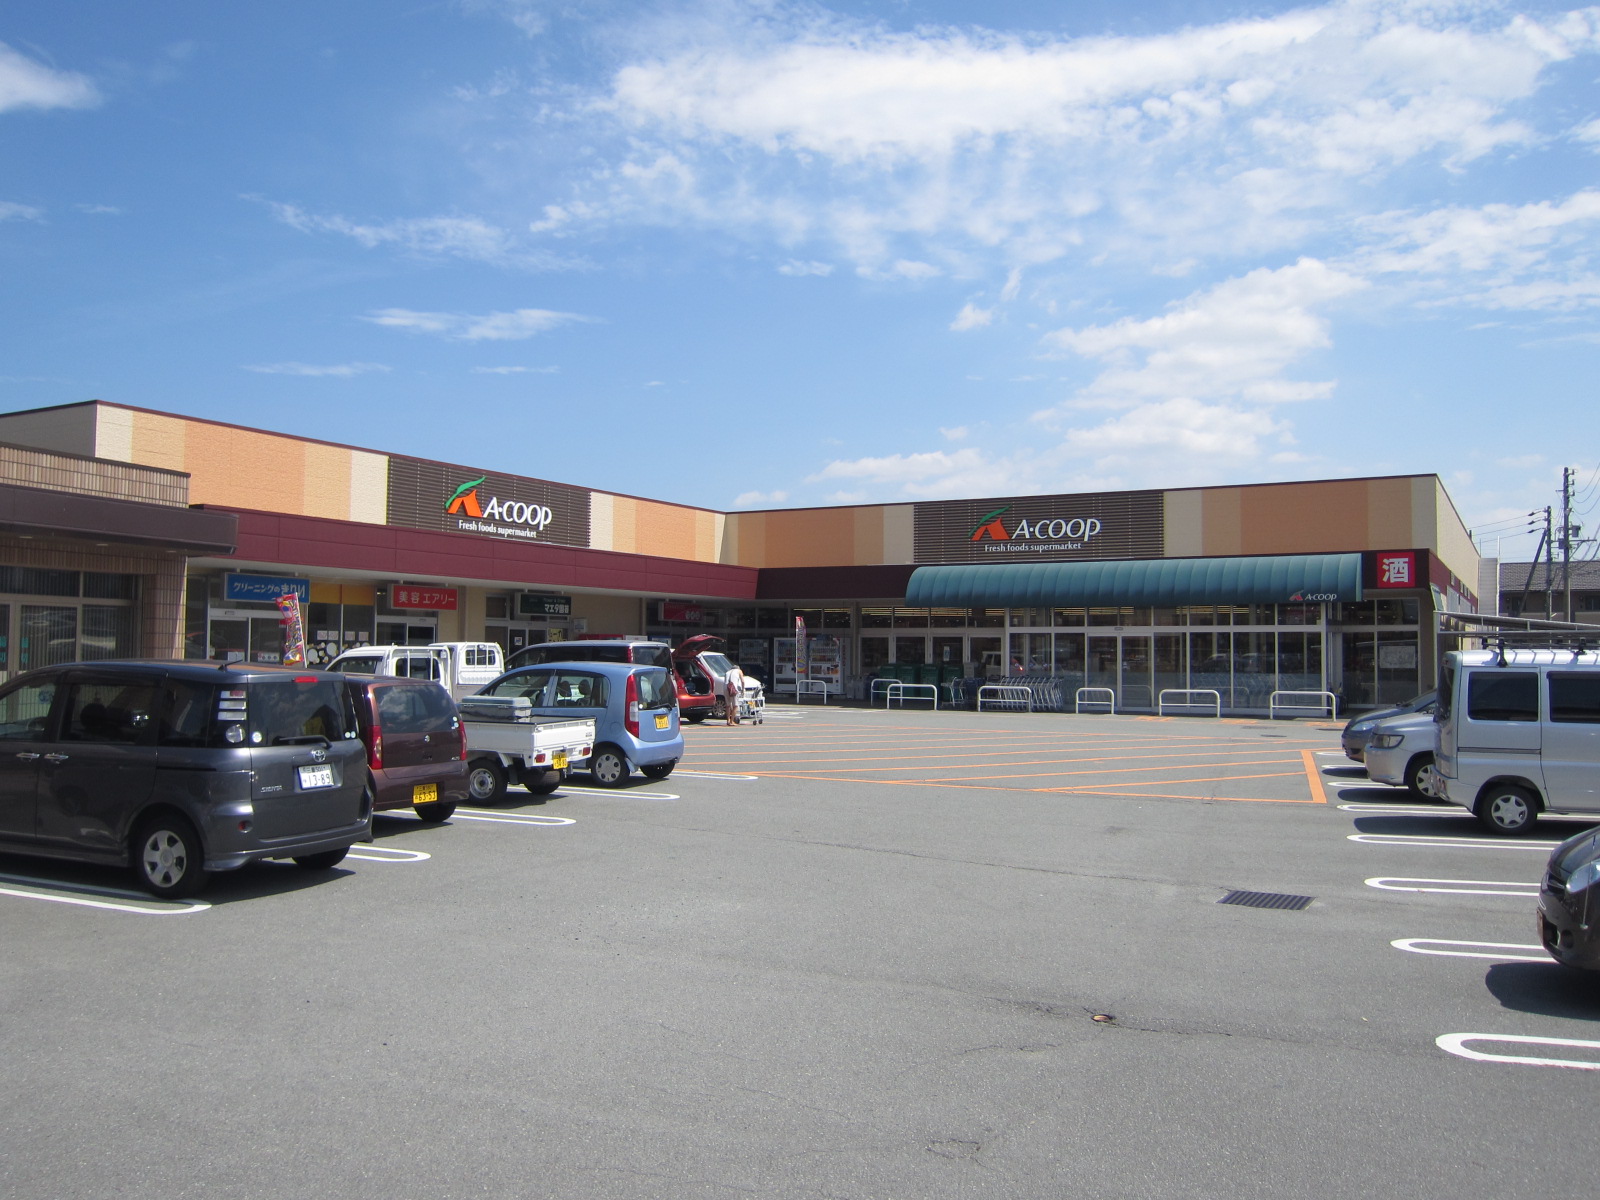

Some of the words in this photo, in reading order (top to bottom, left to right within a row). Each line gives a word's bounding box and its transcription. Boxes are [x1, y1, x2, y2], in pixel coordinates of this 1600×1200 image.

[458, 519, 478, 531] Fresh
[478, 521, 497, 533] foods
[497, 526, 537, 538] supermarket
[984, 544, 1006, 552] Fresh
[1007, 542, 1029, 552] foods
[1030, 541, 1081, 553] supermarket
[1382, 557, 1409, 583] 酒
[399, 591, 455, 605] 美容エアリー
[308, 773, 331, 787] 13-89
